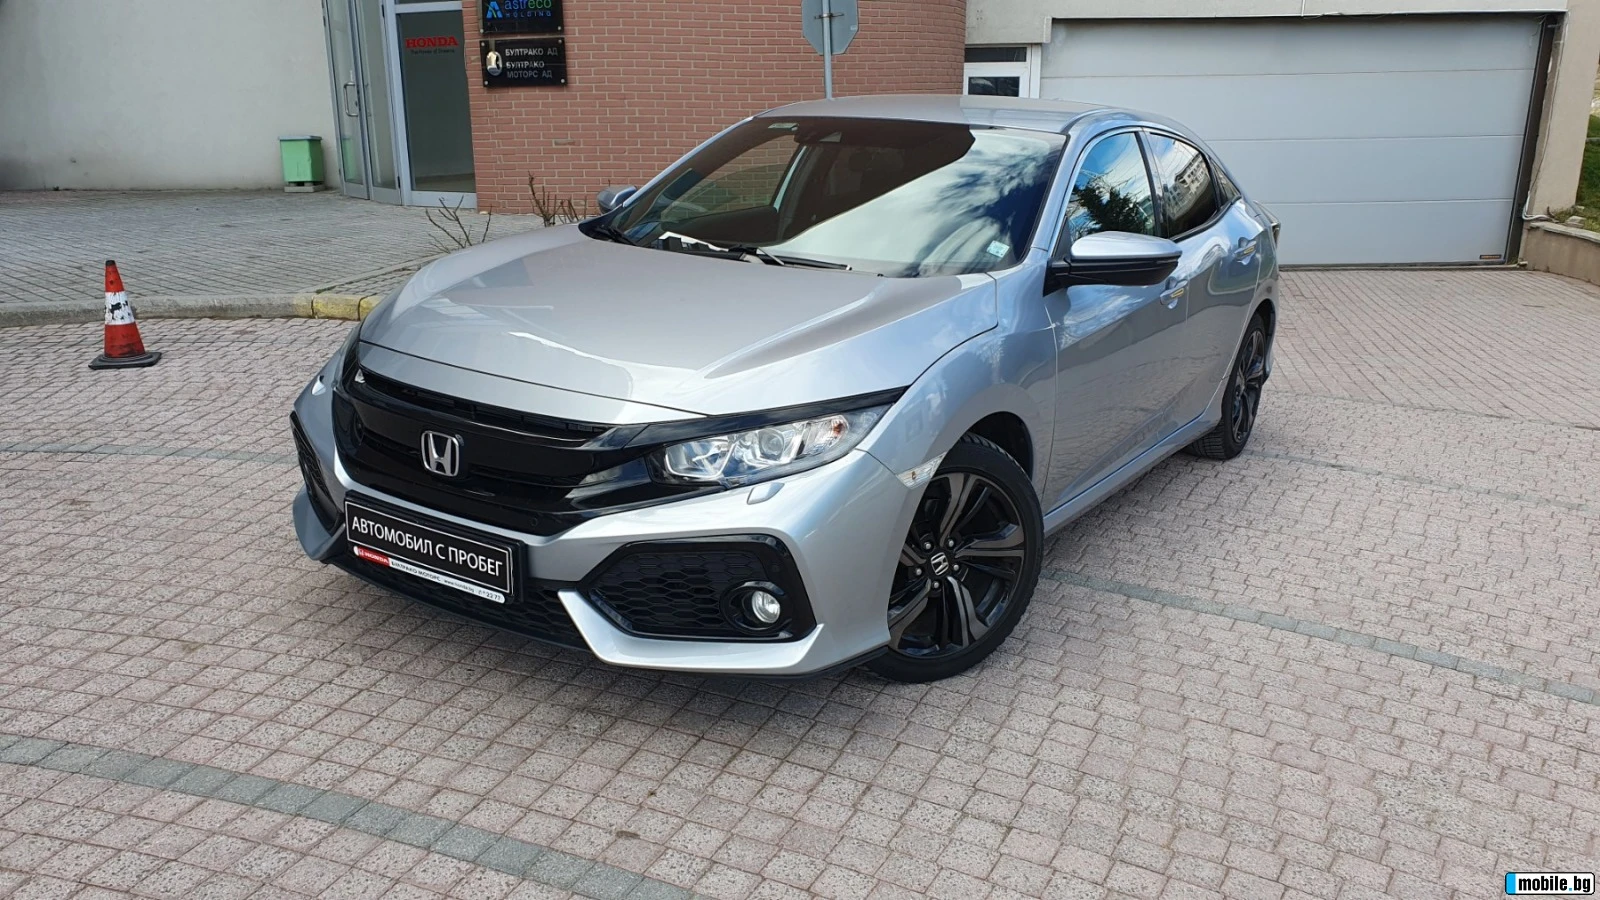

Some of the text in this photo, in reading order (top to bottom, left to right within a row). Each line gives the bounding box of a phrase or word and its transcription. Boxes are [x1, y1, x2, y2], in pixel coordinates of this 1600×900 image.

[405, 35, 459, 48] HONDA
[505, 47, 558, 56] БУЛТРАКО АД
[505, 61, 545, 69] БУЛТРАКО
[507, 70, 538, 78] МОТОРС
[352, 516, 503, 577] АВТОМОБИЛ С ПРОБЕГ
[364, 551, 389, 564] HONDA
